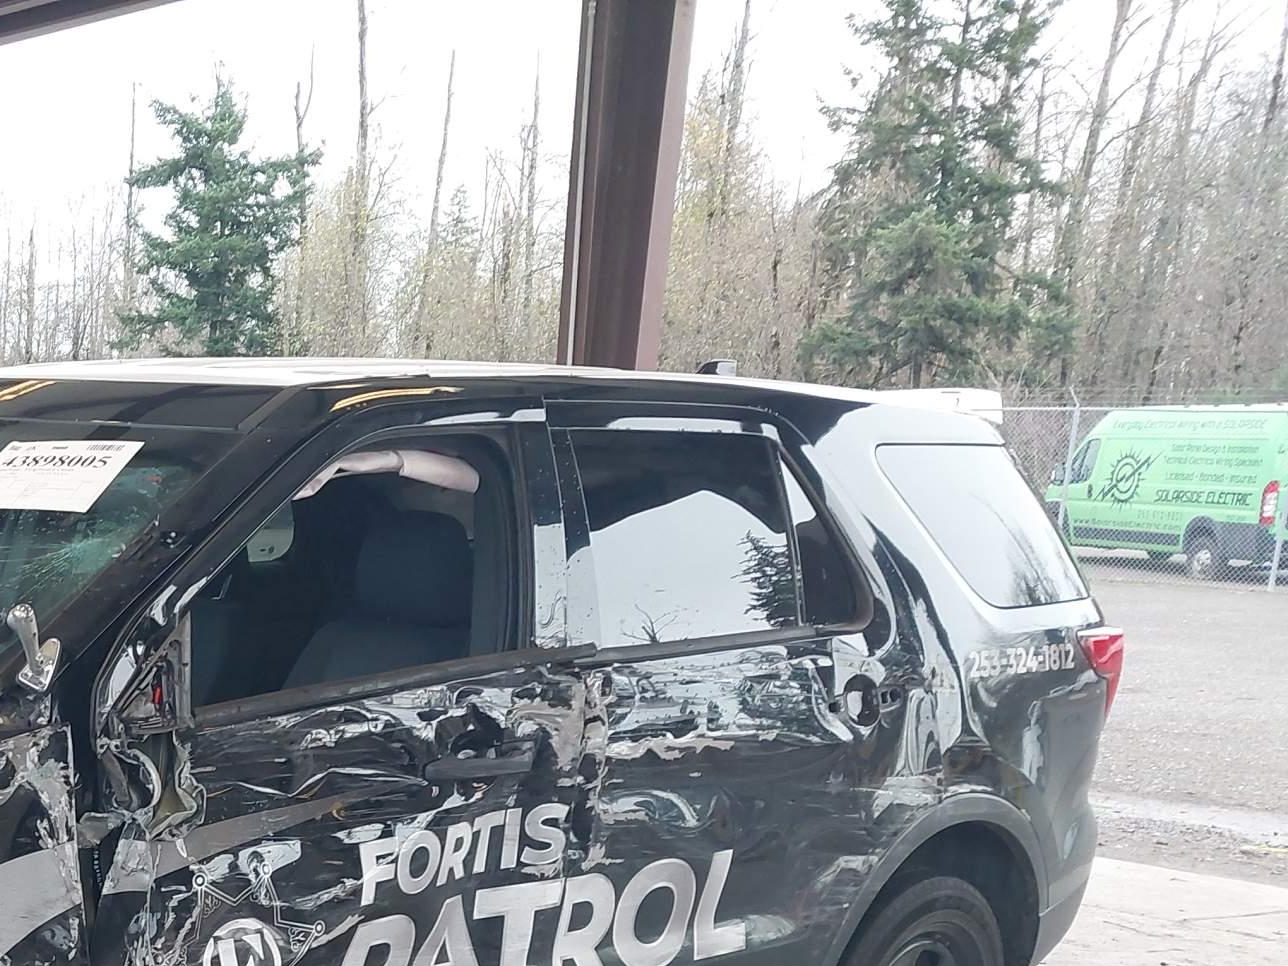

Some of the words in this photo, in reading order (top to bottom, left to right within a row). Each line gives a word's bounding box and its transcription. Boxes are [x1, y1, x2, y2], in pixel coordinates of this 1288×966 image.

[3, 455, 112, 468] 43898005
[1204, 491, 1254, 507] ELECTRIC
[969, 643, 1075, 678] 253-324-1812
[358, 803, 570, 905] FORTIS
